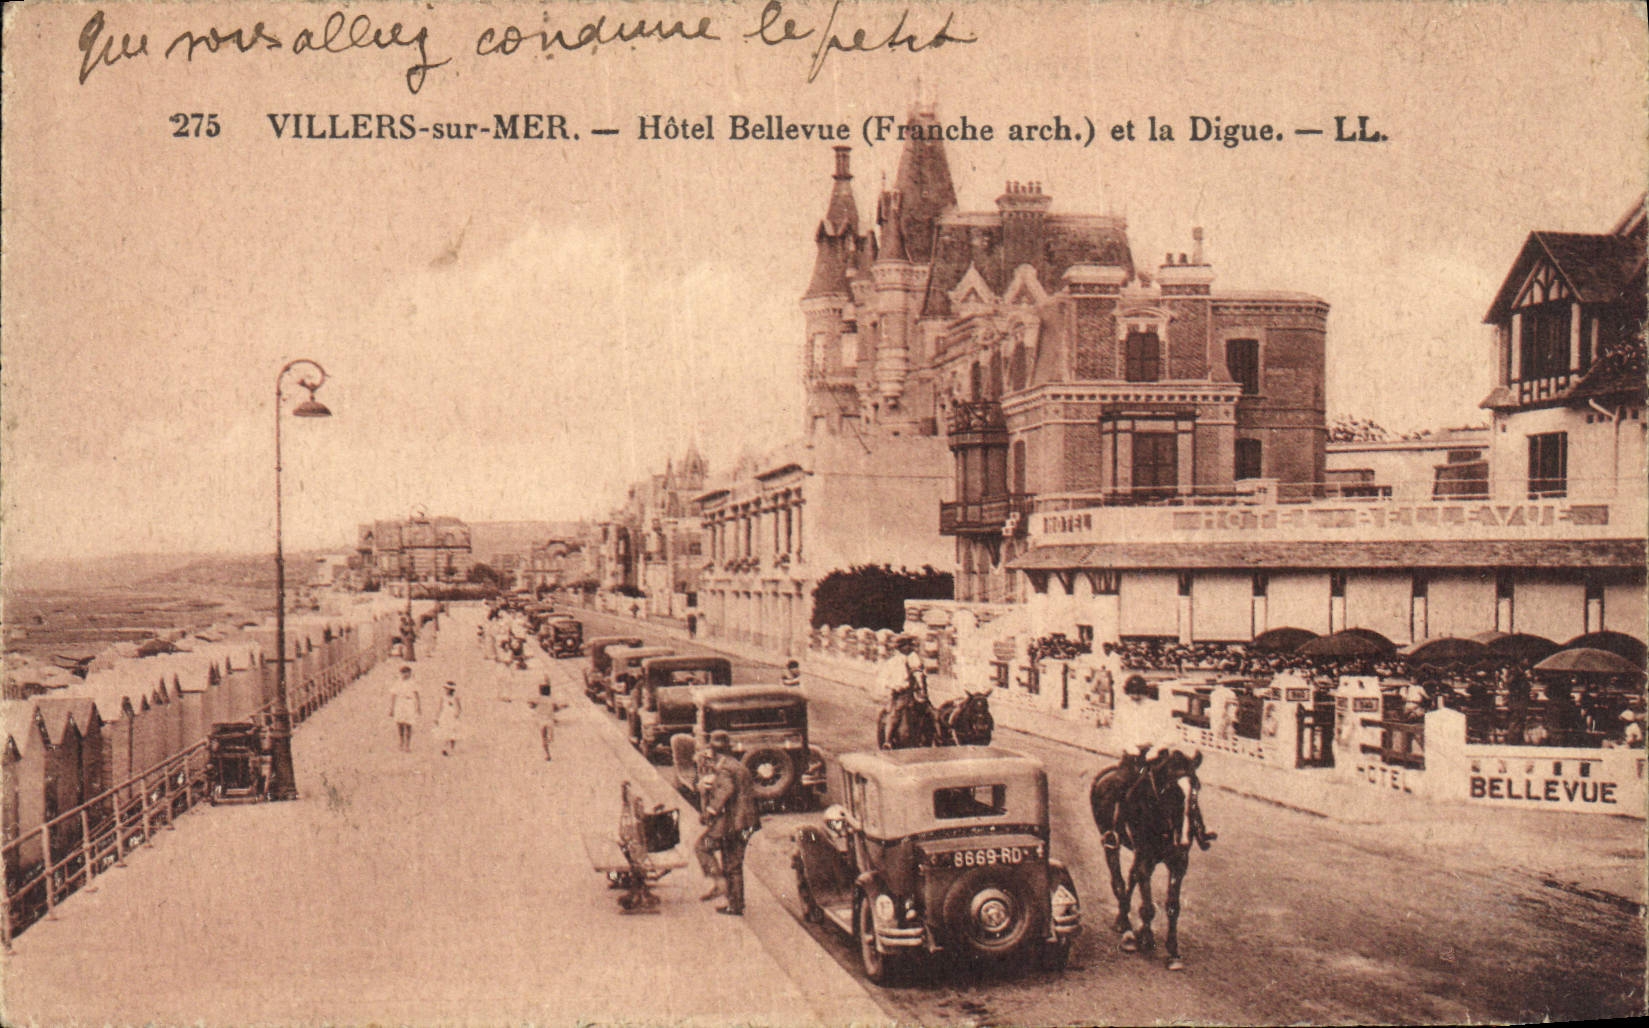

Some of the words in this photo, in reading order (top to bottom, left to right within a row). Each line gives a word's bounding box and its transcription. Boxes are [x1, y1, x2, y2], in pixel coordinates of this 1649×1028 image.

[743, 0, 817, 45] le
[1354, 506, 1572, 528] BELLEVUE
[1469, 775, 1618, 805] BELLEVUE
